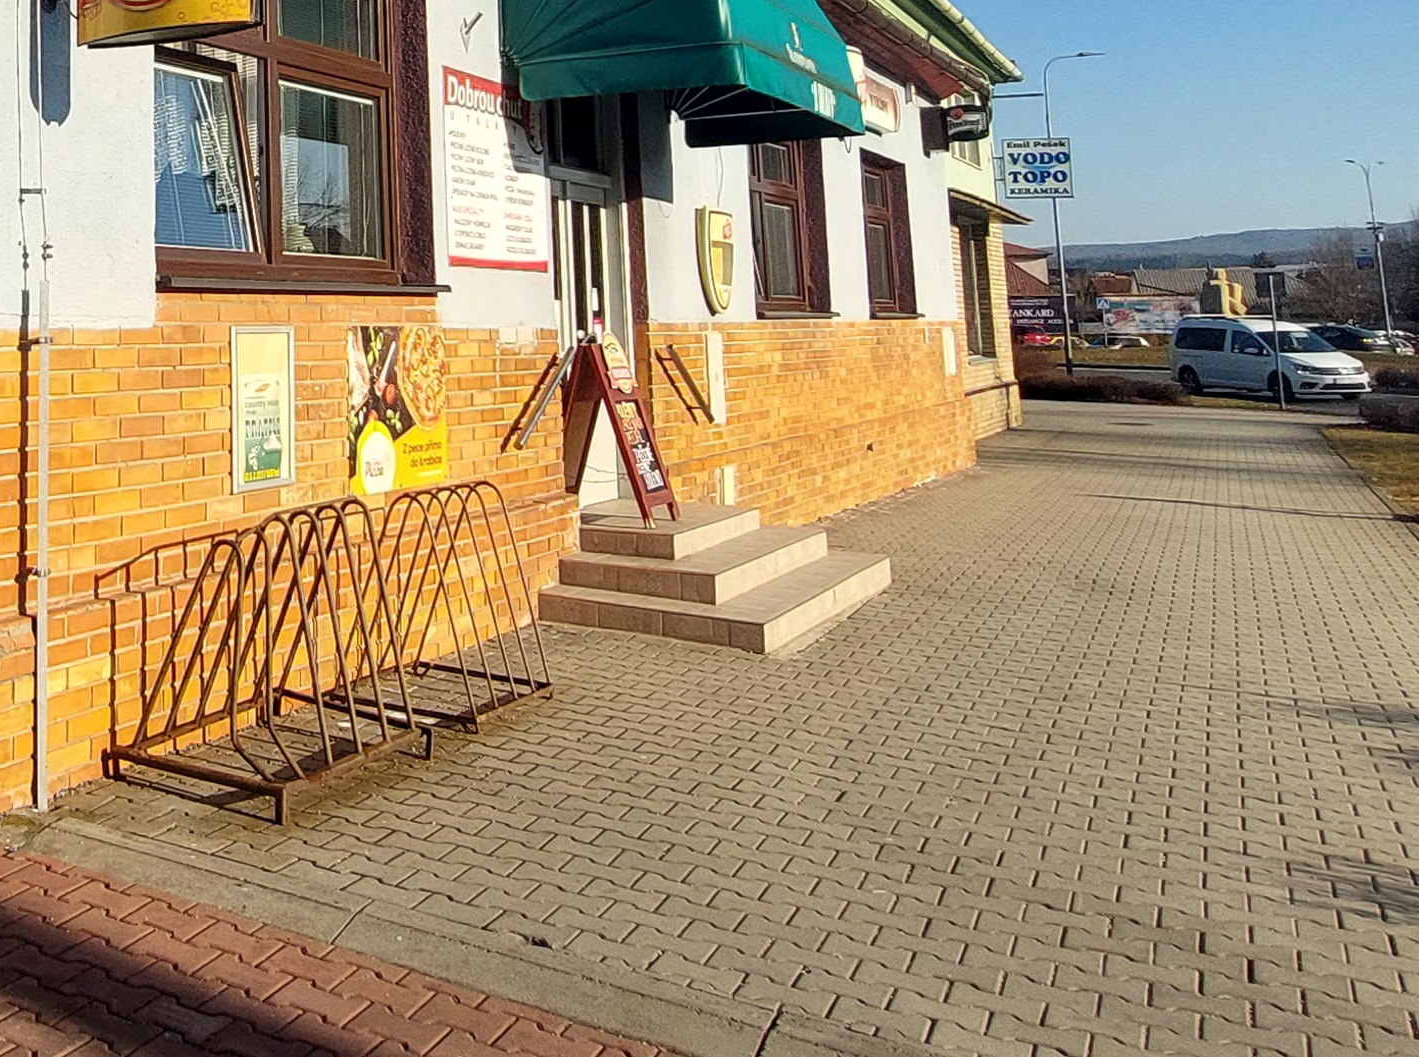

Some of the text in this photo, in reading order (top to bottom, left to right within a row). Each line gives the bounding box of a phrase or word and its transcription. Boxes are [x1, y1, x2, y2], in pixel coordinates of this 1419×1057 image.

[447, 74, 495, 115] Dobrou
[1006, 140, 1030, 148] Emil
[1007, 151, 1070, 165] VODO
[1008, 170, 1068, 183] TOPO
[1009, 187, 1070, 195] KERAMIKA
